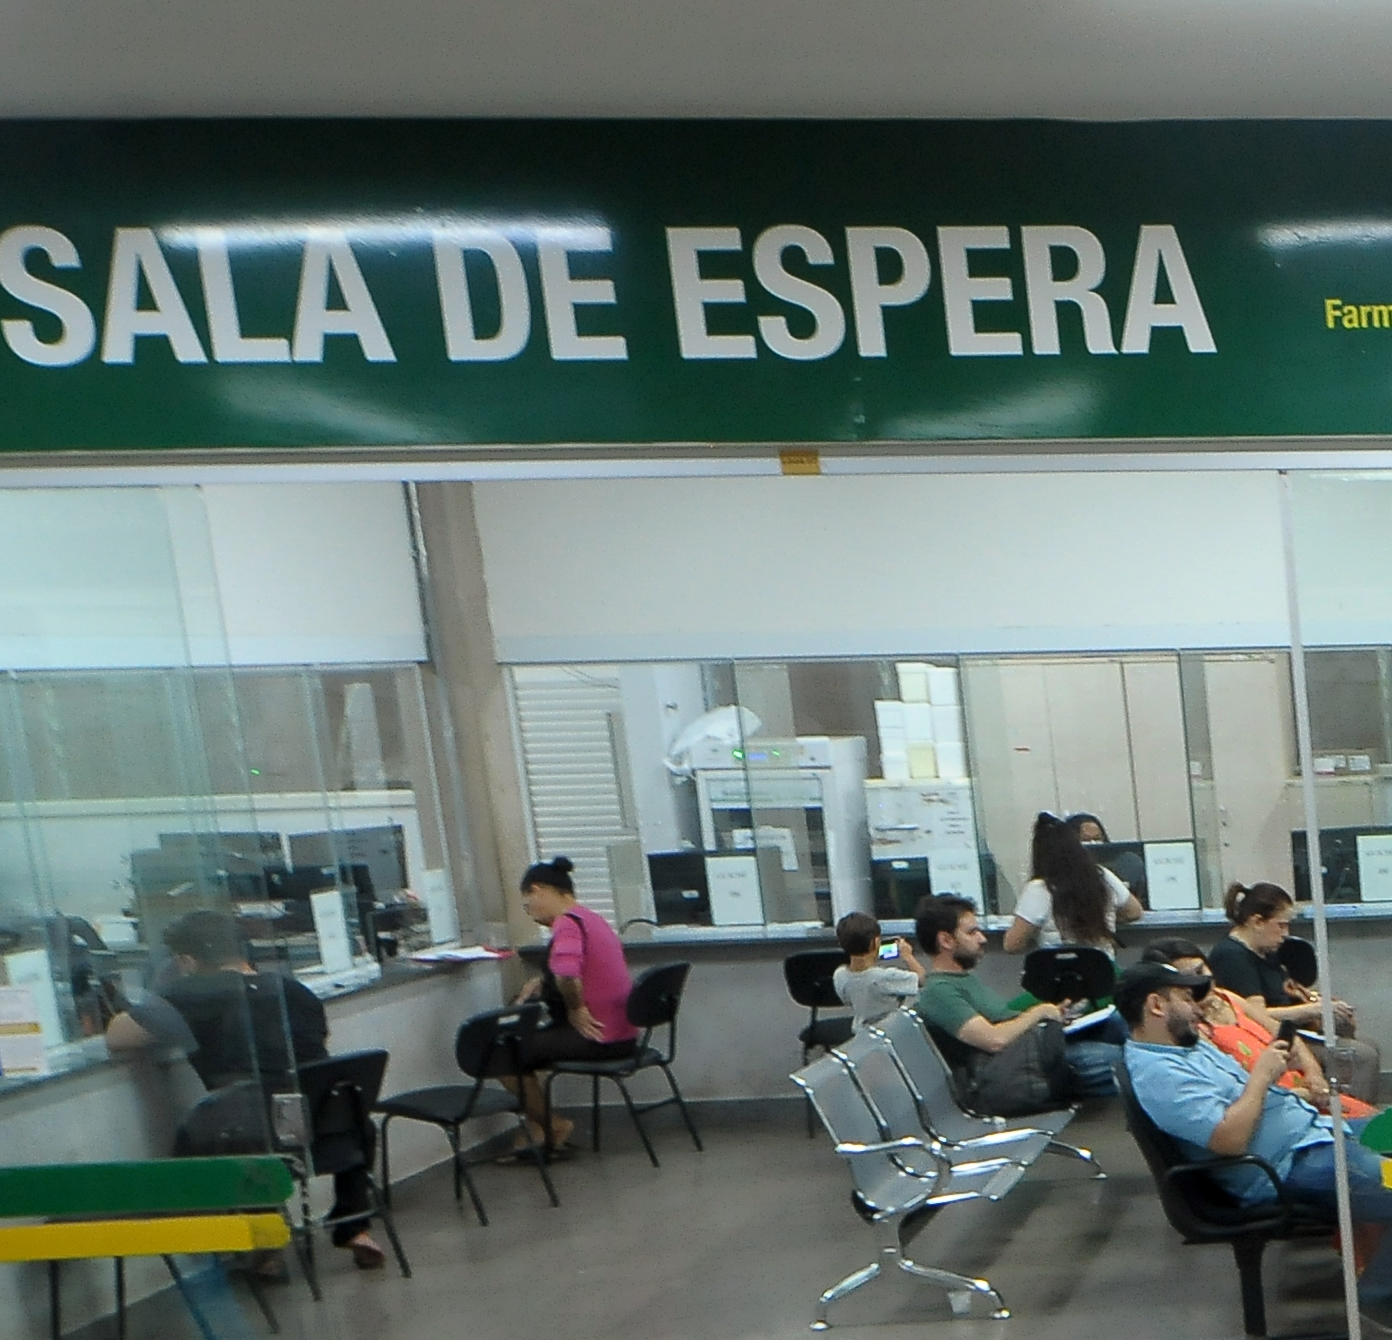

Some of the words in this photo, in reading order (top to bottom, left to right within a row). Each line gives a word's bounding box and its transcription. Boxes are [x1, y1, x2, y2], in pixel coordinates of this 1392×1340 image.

[0, 224, 396, 365] SALA
[434, 223, 628, 363] DE
[666, 225, 1218, 361] ESPERA
